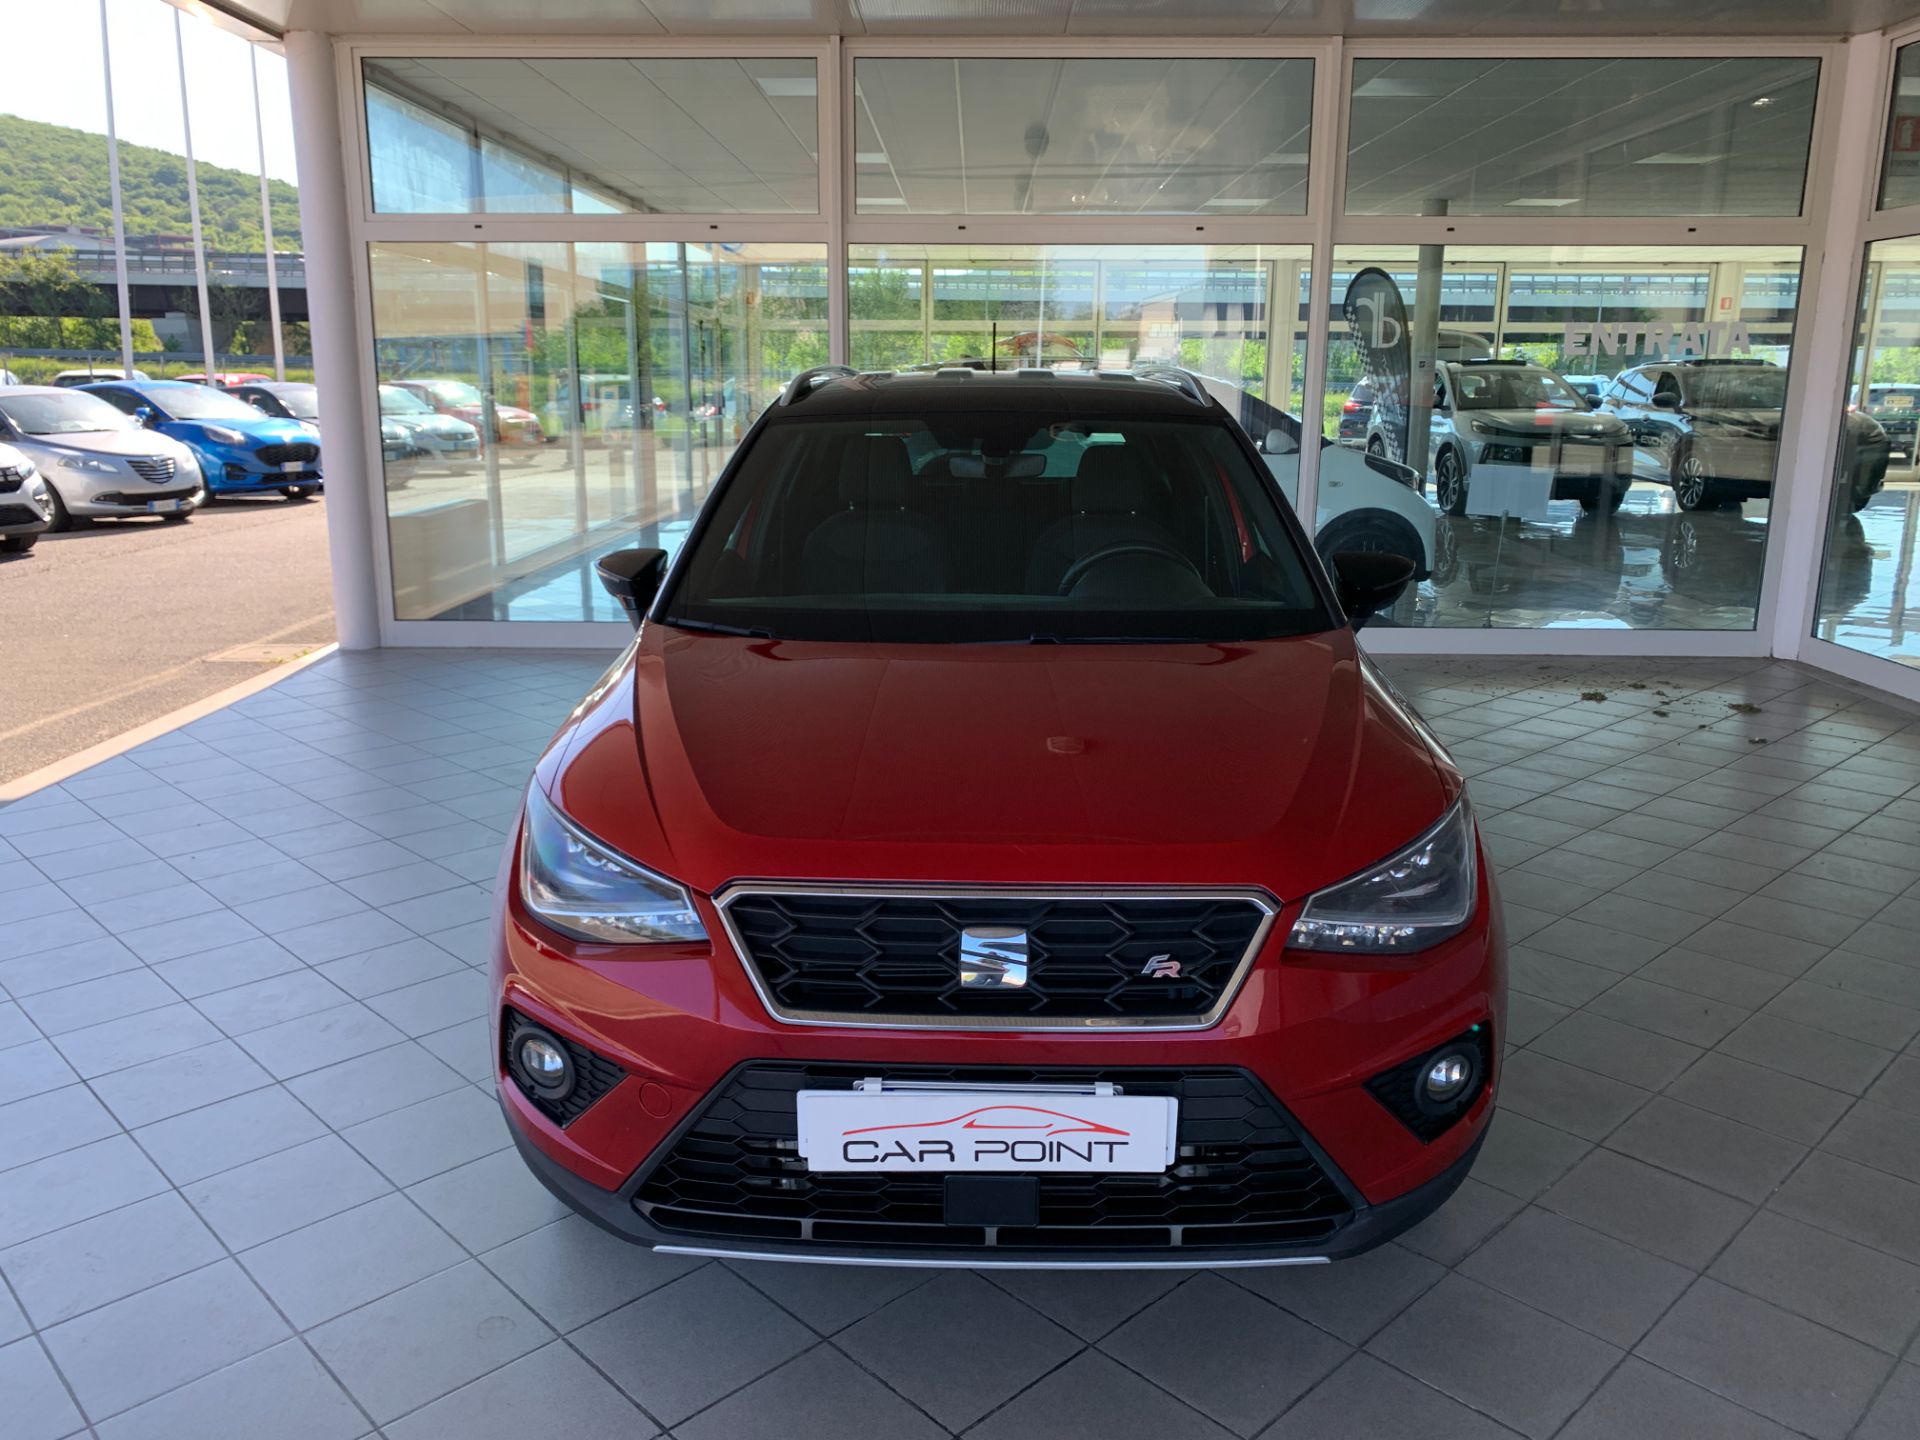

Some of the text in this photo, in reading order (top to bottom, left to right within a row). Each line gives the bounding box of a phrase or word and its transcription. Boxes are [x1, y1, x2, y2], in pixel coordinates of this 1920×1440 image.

[1564, 321, 1750, 355] ENTRATA
[1141, 954, 1181, 978] FR
[842, 1140, 1130, 1163] CAR POINT
